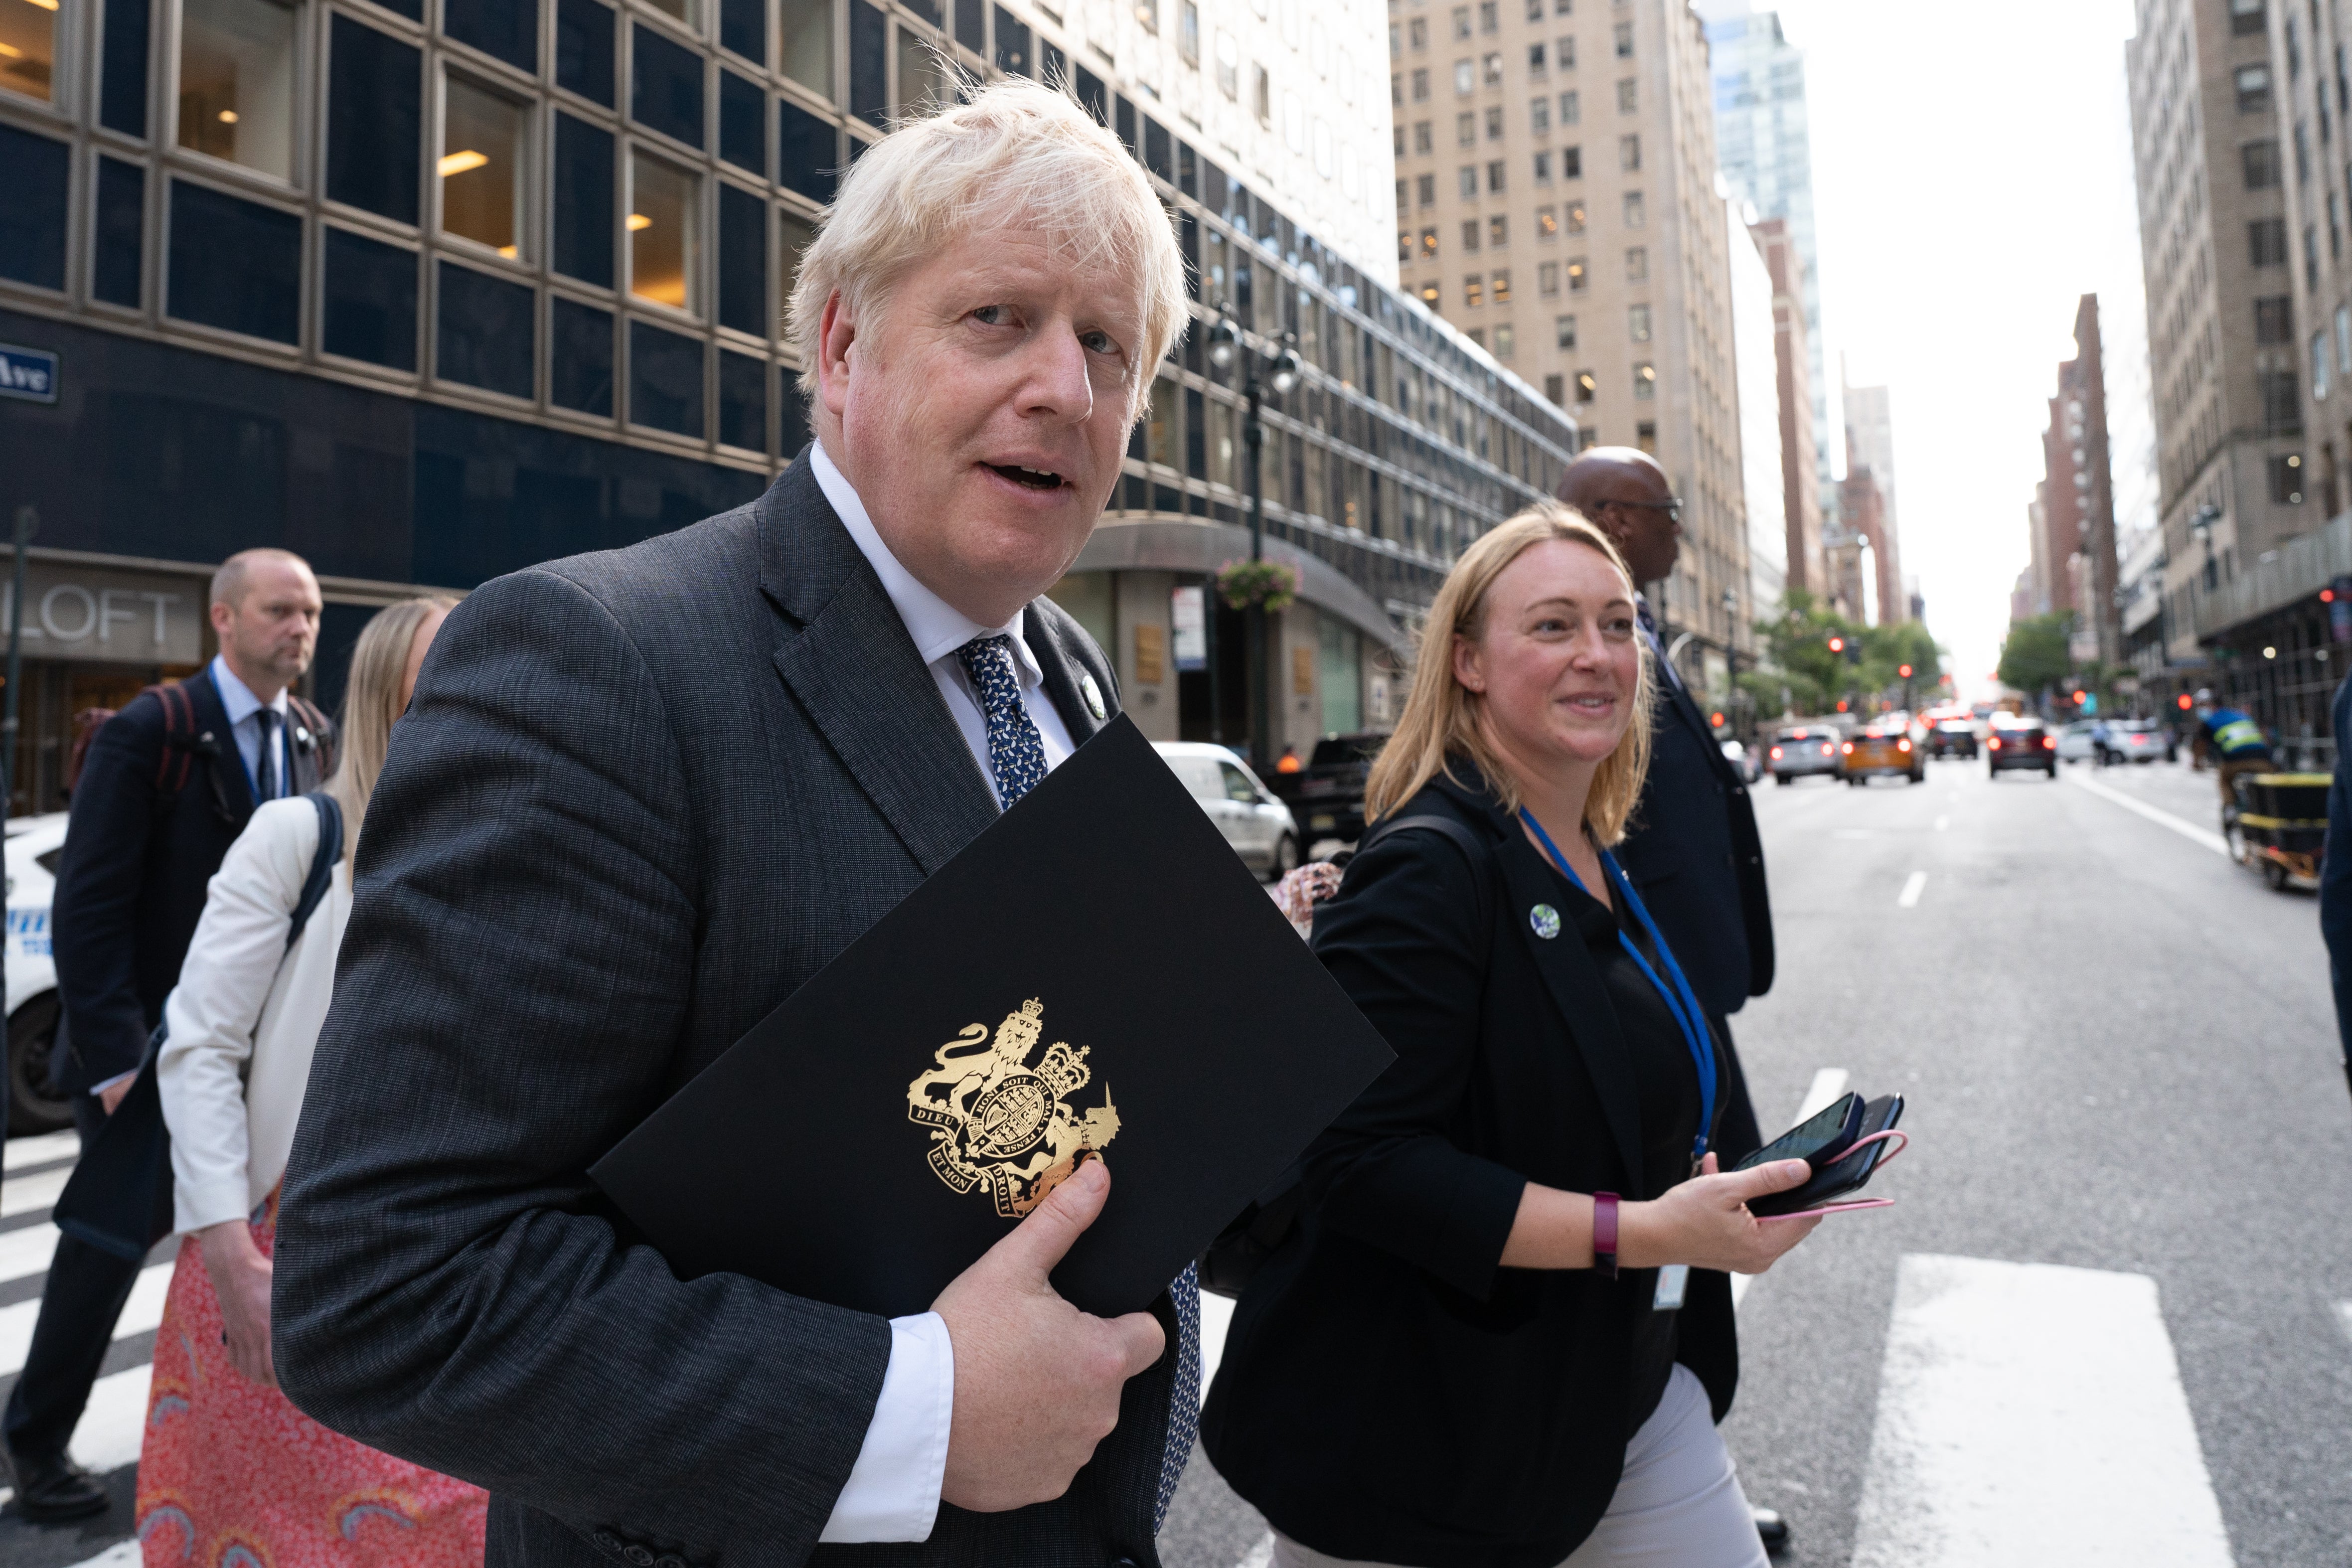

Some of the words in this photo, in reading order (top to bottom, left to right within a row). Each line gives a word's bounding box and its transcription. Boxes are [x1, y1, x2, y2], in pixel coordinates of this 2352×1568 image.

[2, 581, 182, 642] LOFT
[1002, 1077, 1029, 1089] SOIT
[1033, 1080, 1049, 1097] QUI
[976, 1087, 999, 1113] HONI
[916, 1109, 954, 1125] DIEU
[1041, 1100, 1052, 1123] MAL
[1003, 1132, 1037, 1153] PENSE
[932, 1151, 946, 1167] ET
[941, 1166, 968, 1189] MON
[993, 1166, 1010, 1211] DROIT
